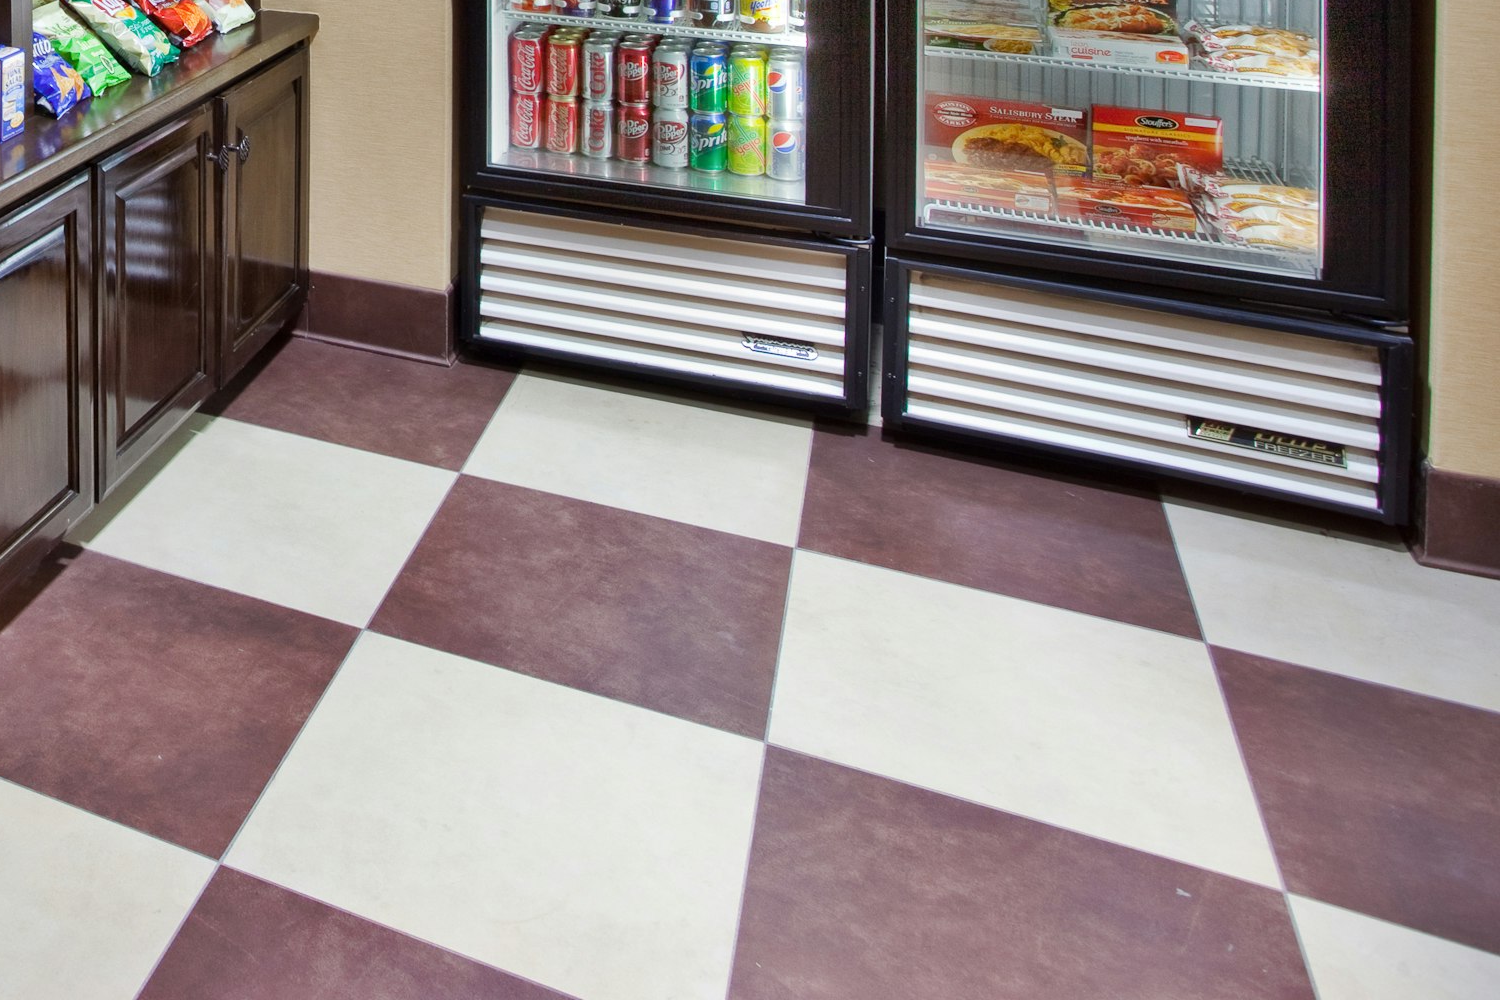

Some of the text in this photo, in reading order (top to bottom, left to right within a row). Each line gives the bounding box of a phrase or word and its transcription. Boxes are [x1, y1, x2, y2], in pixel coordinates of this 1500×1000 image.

[1071, 45, 1112, 57] cuisine
[7, 68, 22, 81] TUNA
[4, 76, 23, 92] SALAD
[938, 100, 971, 112] BOSTON
[990, 105, 1043, 120] SALISBURY
[940, 114, 977, 127] MARKET
[1140, 116, 1174, 129] Stouffer's
[657, 125, 685, 142] Pepper
[1162, 137, 1190, 146] meatballs
[1254, 441, 1336, 463] FREEZER
